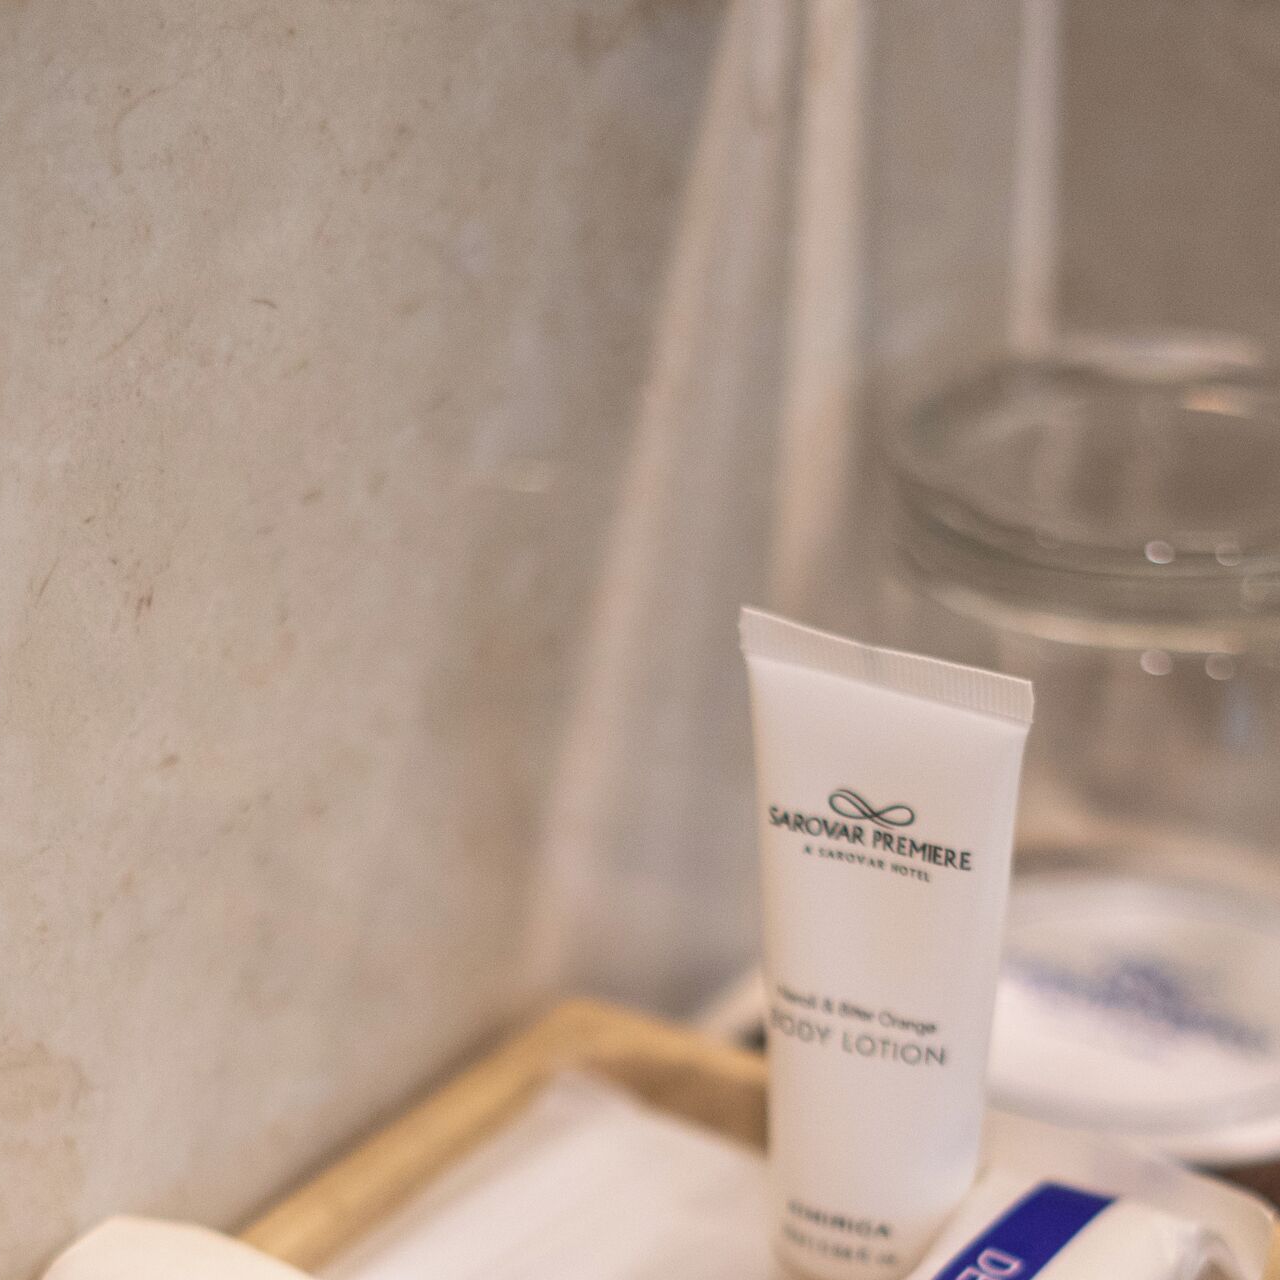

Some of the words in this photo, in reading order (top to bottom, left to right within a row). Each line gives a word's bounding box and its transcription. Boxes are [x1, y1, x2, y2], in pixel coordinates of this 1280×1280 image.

[768, 804, 865, 846] SAROVAR
[872, 829, 973, 872] PREMIERE
[818, 847, 886, 871] SAROVAR
[891, 862, 931, 884] HOTEL
[878, 1011, 937, 1036] Orange
[841, 1031, 947, 1066] LOTION
